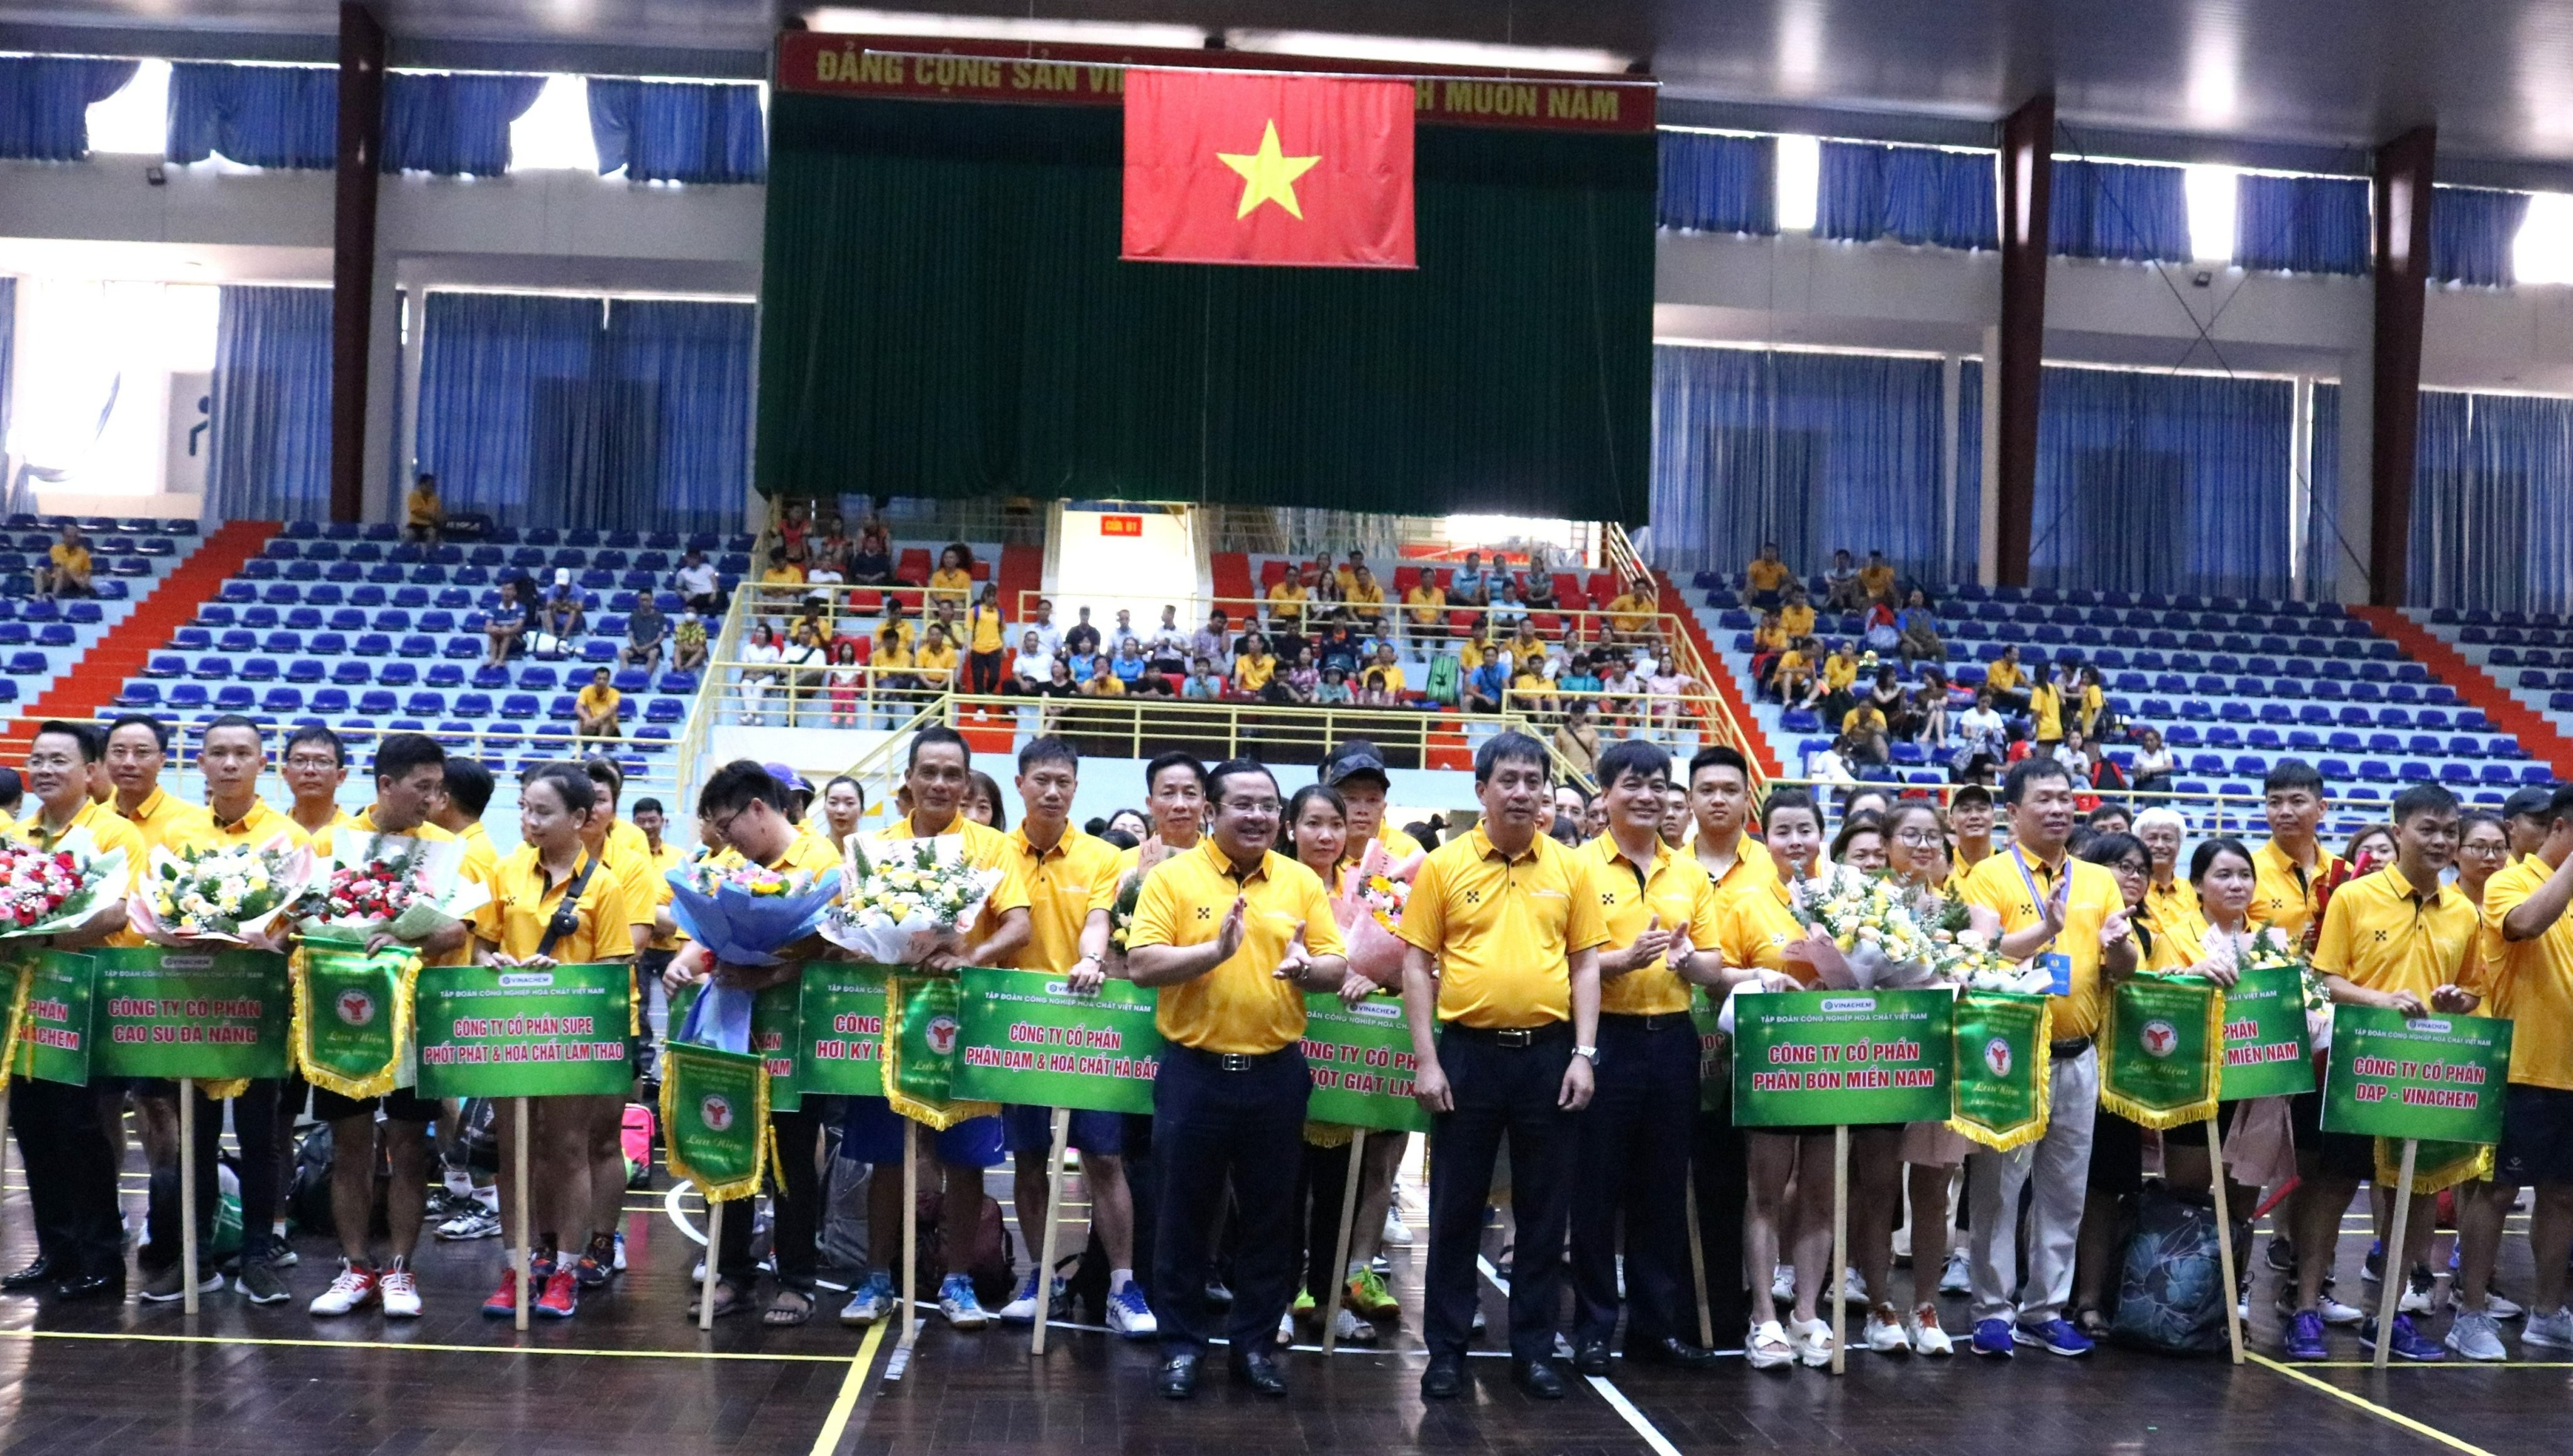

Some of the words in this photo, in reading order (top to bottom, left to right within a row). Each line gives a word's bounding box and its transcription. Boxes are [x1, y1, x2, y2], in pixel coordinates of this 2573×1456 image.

[817, 40, 904, 84] ĐẢNG
[914, 48, 1002, 92] CỘNG
[27, 996, 68, 1023] PHẦN
[109, 995, 156, 1017] CÔNG
[160, 999, 180, 1017] TY
[212, 994, 262, 1018] PHẦN
[1000, 992, 1023, 1001] ĐOÀN
[1024, 995, 1047, 1003] CÔNG
[834, 1011, 882, 1035] CÔNG
[1306, 1011, 1323, 1019] OÀN
[1325, 1013, 1347, 1022] CÔNG
[1358, 1006, 1397, 1016] VINACHEM
[1894, 1012, 1909, 1021] VIỆT
[112, 1024, 148, 1043] CAO
[151, 1025, 175, 1043] SU
[454, 1016, 487, 1038] CÔNG
[490, 1019, 504, 1036] TY
[507, 1012, 523, 1036] CỔ
[525, 1012, 559, 1036] PHẦN
[562, 1016, 593, 1035] SUPE
[1009, 1021, 1044, 1044] CÔNG
[1047, 1028, 1063, 1045] TY
[1066, 1023, 1085, 1046] CỔ
[1086, 1026, 1122, 1051] PHẦN
[2388, 1031, 2408, 1039] CÔNG
[2417, 1021, 2448, 1029] VINACHEM
[423, 1040, 455, 1065] PHỐT
[493, 1045, 501, 1062] &
[533, 1037, 562, 1060] CHẤT
[564, 1040, 591, 1060] LÂM
[593, 1041, 624, 1060] THAO
[816, 1039, 846, 1059] HƠI
[849, 1039, 872, 1060] KỸ
[964, 1045, 1001, 1066] PHÂN
[1004, 1048, 1033, 1073] ĐẠM
[1036, 1053, 1046, 1070] &
[1079, 1053, 1111, 1076] CHẤT
[1113, 1056, 1132, 1078] HÀ
[1298, 1036, 1334, 1060] ÔNG
[1339, 1045, 1360, 1063] TY
[1364, 1043, 1392, 1067] CỔ
[1393, 1051, 1418, 1071] PH
[1769, 1041, 1816, 1064] CÔNG
[1821, 1044, 1841, 1062] TY
[1845, 1037, 1870, 1062] CỔ
[1872, 1036, 1920, 1061] PHẦN
[2227, 1041, 2264, 1067] MIỀN
[2265, 1041, 2299, 1062] NAM
[1343, 1070, 1385, 1095] GIẶT
[1752, 1068, 1801, 1090] PHÂN
[1805, 1069, 1842, 1090] BÓN
[1845, 1064, 1891, 1089] MIỀN
[1894, 1068, 1935, 1087] NAM
[2354, 1055, 2396, 1077] CÔNG
[2401, 1060, 2418, 1078] TY
[2422, 1057, 2444, 1080] CỔ
[2444, 1060, 2486, 1084] PHẦN
[2356, 1083, 2388, 1102] DAP
[2401, 1087, 2479, 1109] VINACHEM
